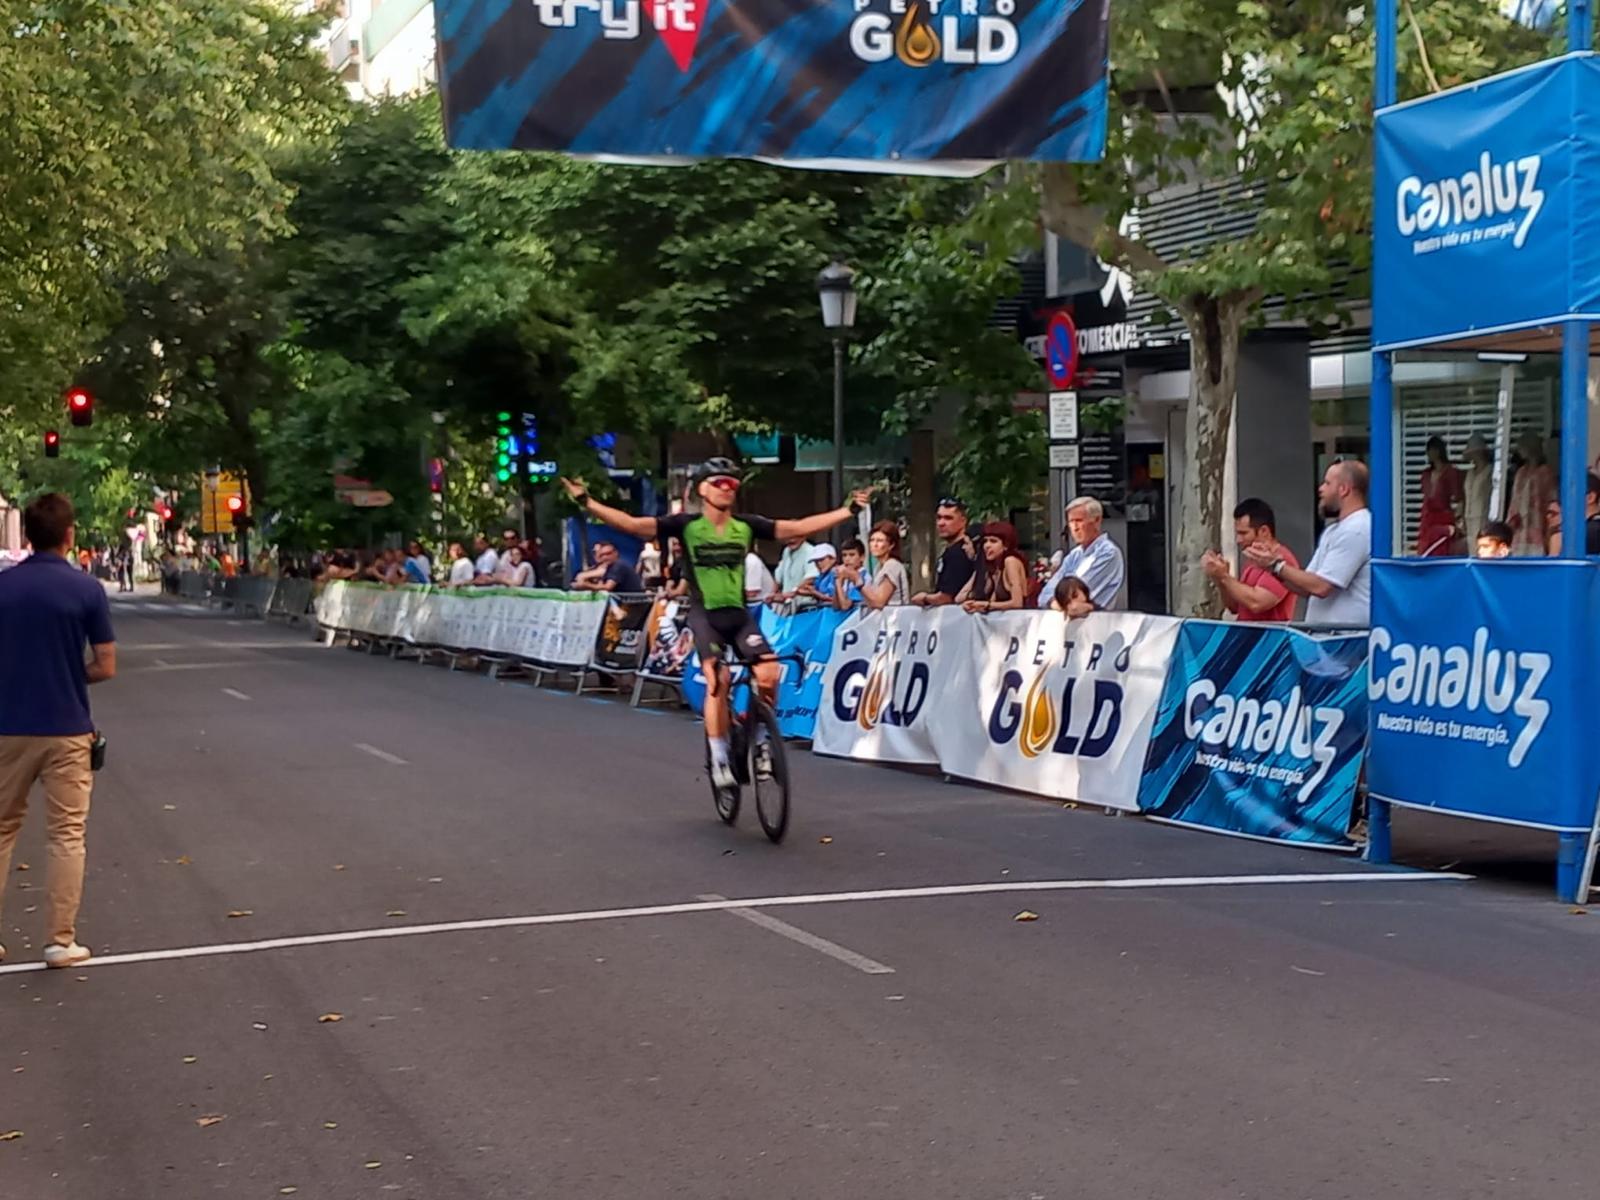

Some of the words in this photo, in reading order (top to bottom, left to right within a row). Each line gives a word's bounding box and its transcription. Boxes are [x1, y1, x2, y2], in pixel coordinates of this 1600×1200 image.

[533, 0, 640, 39] try
[653, 0, 696, 31] it
[1396, 150, 1545, 249] Canaluz
[841, 629, 939, 656] PETRO
[1004, 635, 1134, 673] PETRO
[1367, 626, 1551, 768] Canaluz
[1184, 678, 1345, 803] Canaluz
[1377, 712, 1412, 733] Nuestra
[1413, 715, 1434, 736] vida
[1434, 721, 1448, 737] es
[1448, 720, 1461, 738] tu
